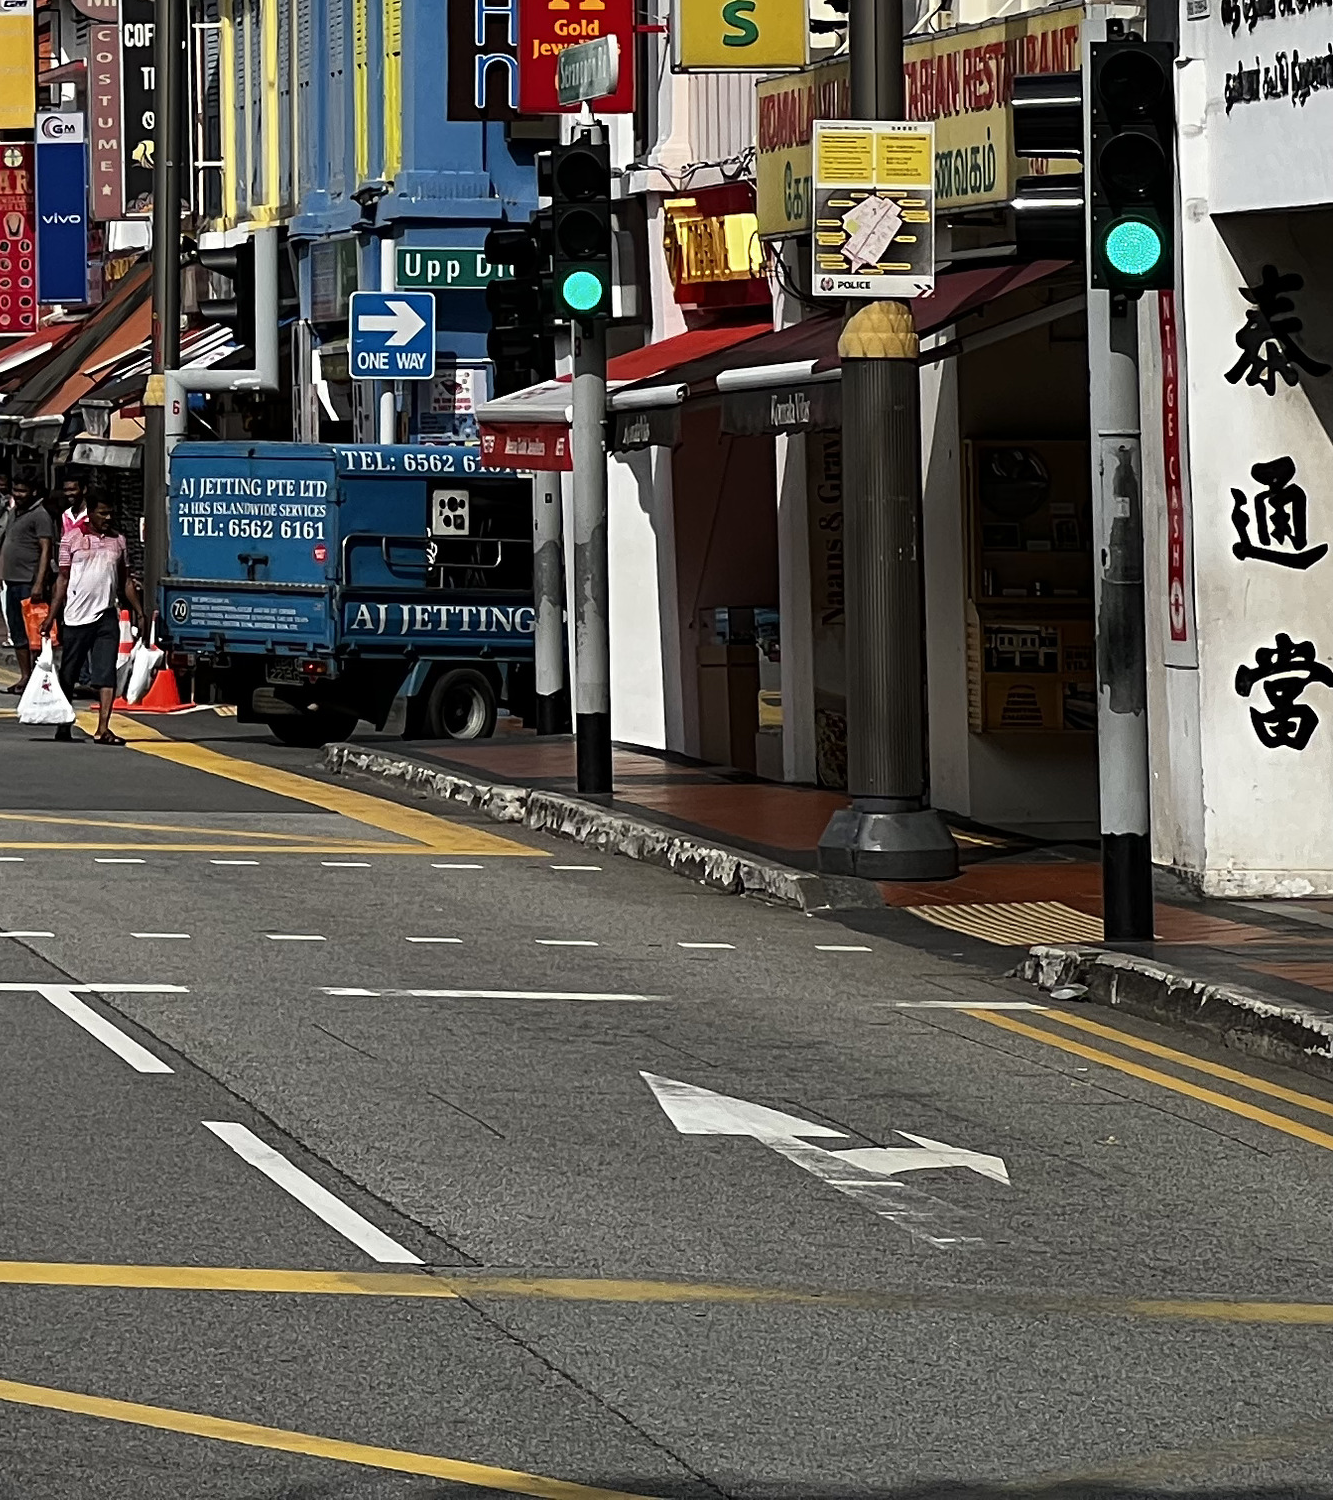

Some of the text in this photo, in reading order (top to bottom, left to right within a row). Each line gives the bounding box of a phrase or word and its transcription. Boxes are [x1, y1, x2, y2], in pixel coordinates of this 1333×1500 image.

[553, 19, 601, 36] Gold
[904, 49, 960, 122] TARIAN
[96, 30, 118, 172] COSTUME
[41, 212, 82, 225] vivo
[404, 252, 461, 284] Upp
[837, 280, 871, 290] POLICE
[357, 352, 427, 370] ONE WAY
[341, 450, 397, 472] TEL:
[403, 452, 456, 473] 6562
[179, 477, 328, 499] AJ JETTING PTE LTD
[178, 501, 327, 518] 24 HRS ISLANDWIDE SERVICES
[178, 516, 326, 540] TEL: 6562 6161
[173, 602, 187, 617] 70
[350, 603, 536, 635] AJ JETTING
